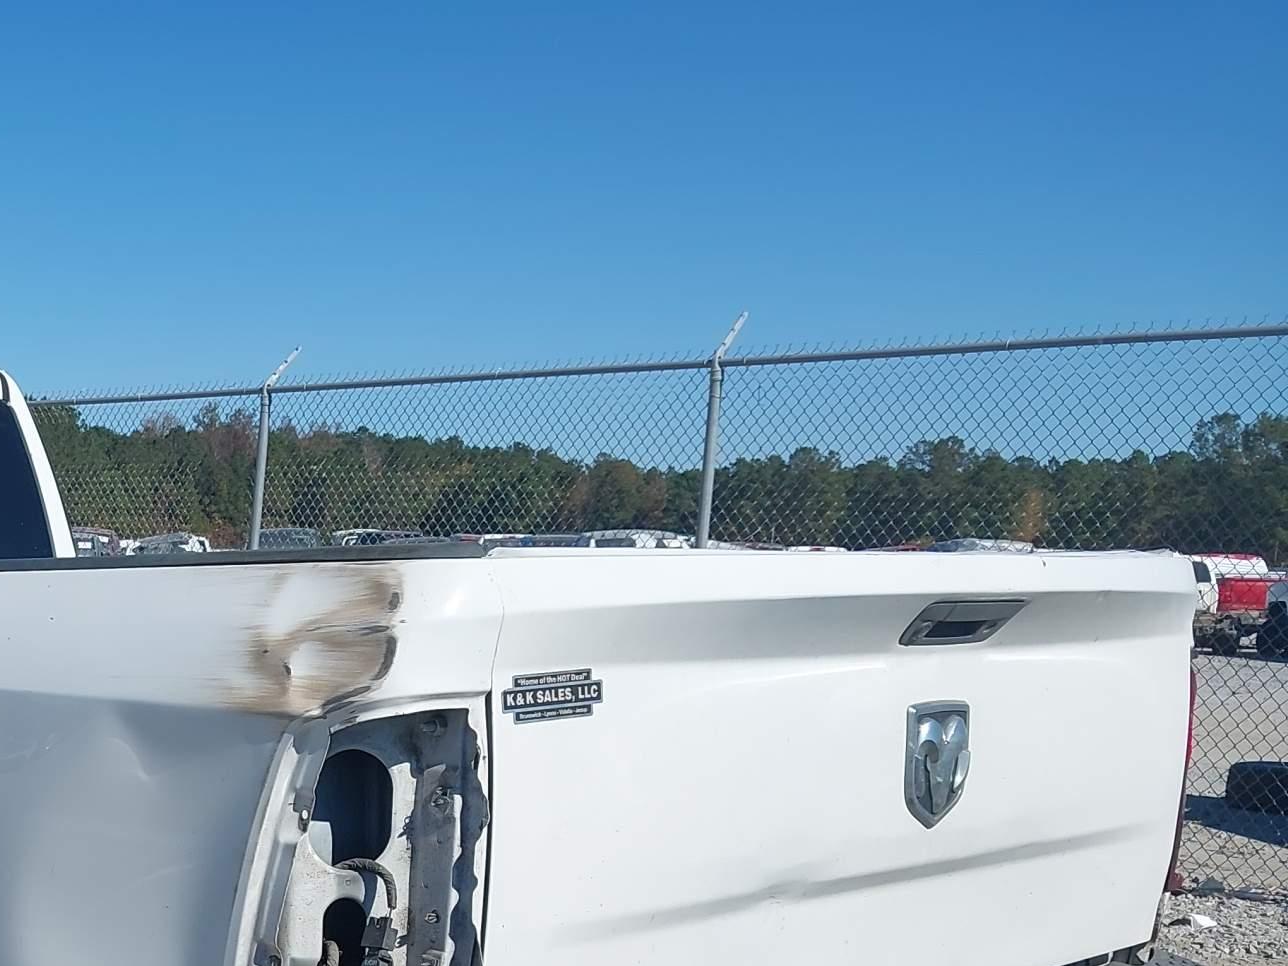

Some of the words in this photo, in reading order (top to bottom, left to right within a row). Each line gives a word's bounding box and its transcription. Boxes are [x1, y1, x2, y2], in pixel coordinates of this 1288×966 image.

[557, 673, 571, 682] HOT
[536, 687, 576, 703] SALES,
[578, 684, 599, 699] LLC
